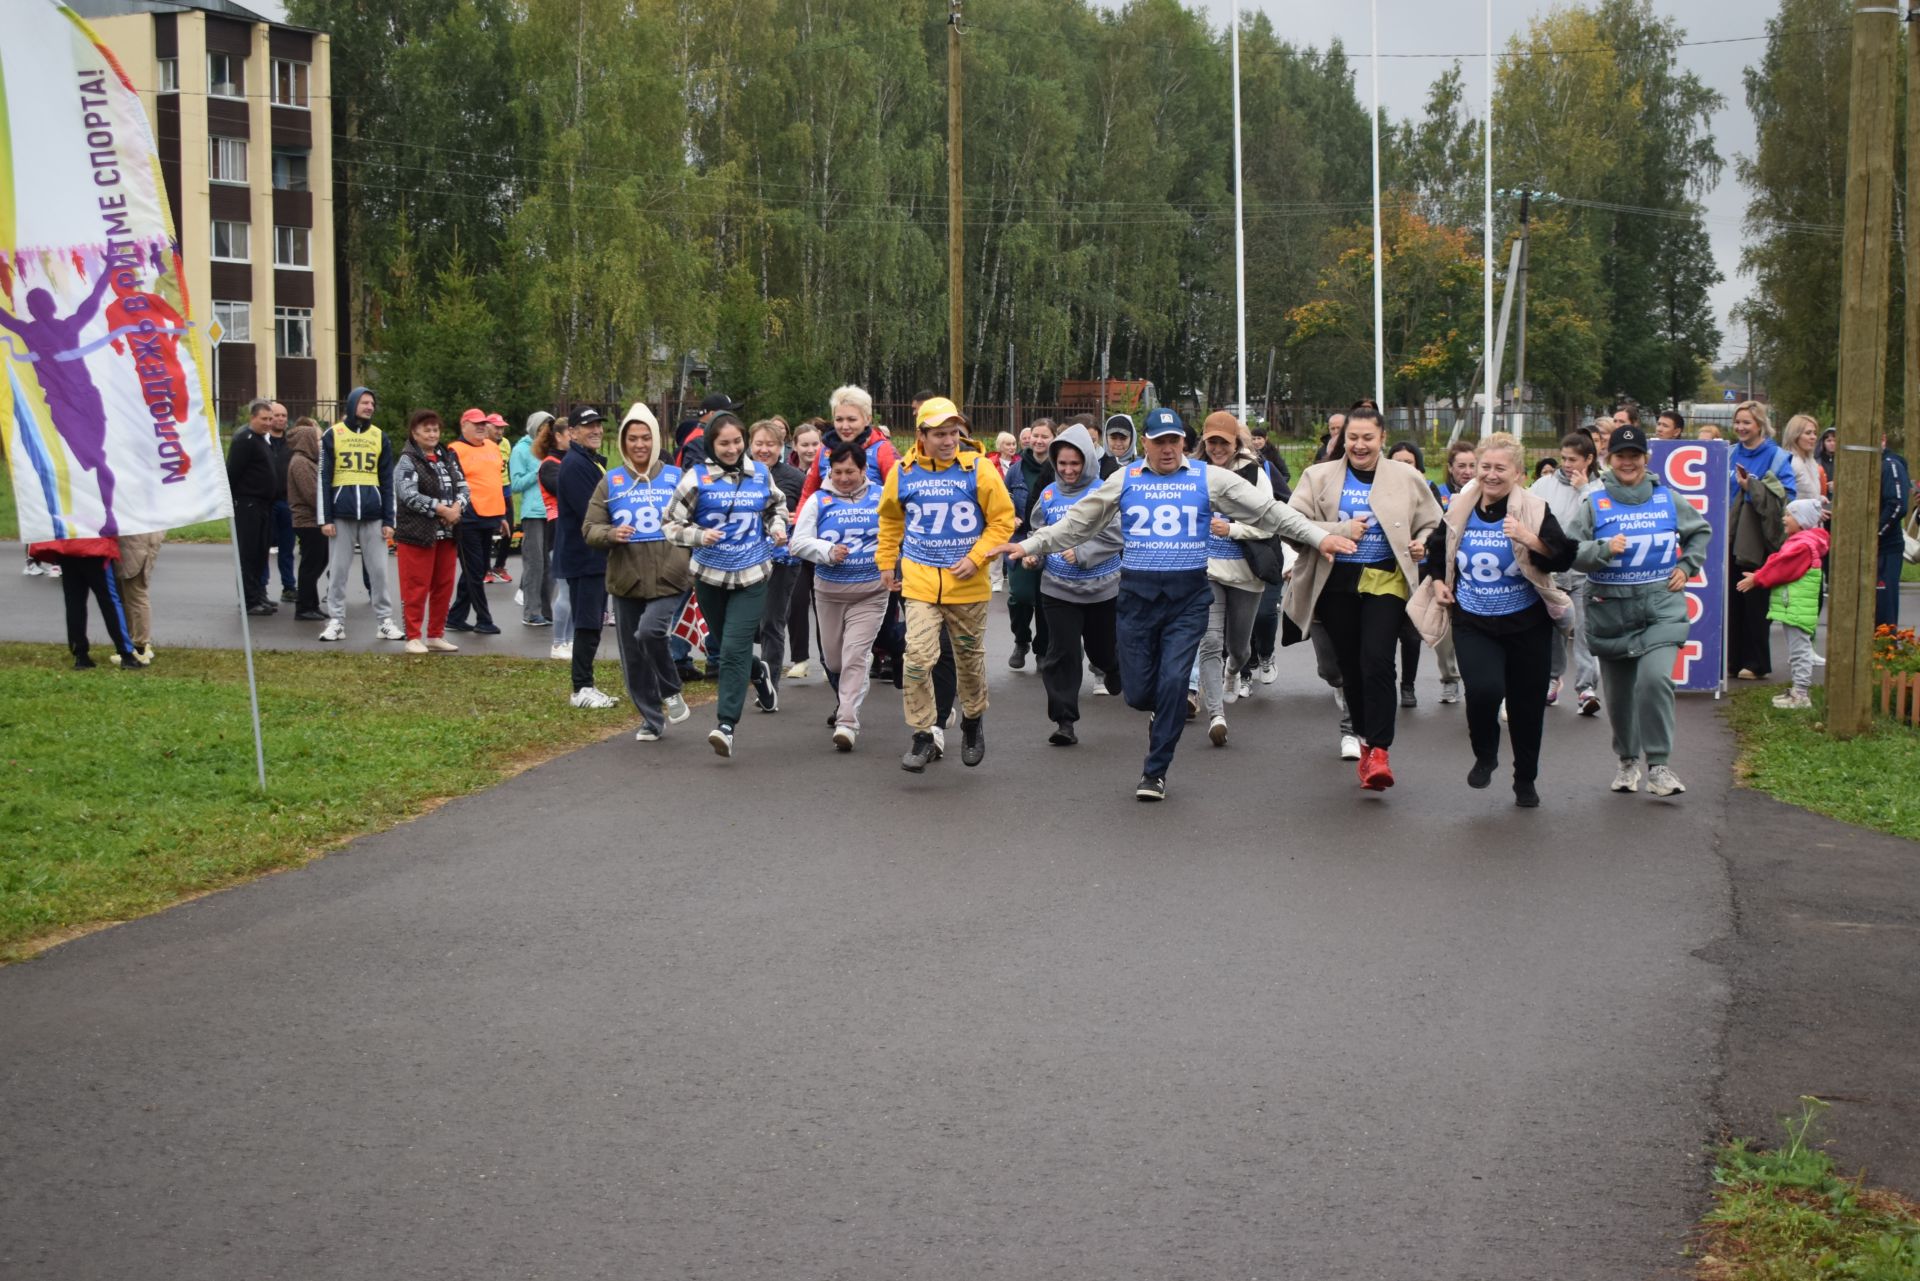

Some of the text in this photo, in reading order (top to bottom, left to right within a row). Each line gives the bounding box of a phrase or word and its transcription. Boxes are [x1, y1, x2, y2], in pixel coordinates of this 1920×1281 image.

[77, 69, 187, 485] МОЛОДЕЖЬ В РИТМЕ СПОРТА!
[339, 451, 377, 472] 315
[907, 479, 967, 491] ТУКАЕВСКИЙ
[1131, 483, 1197, 492] ТУКАЕВСКИЙ
[707, 490, 764, 500] ТУКАЕВСКИЙ
[919, 486, 954, 496] РАЙОН
[1144, 490, 1182, 500] РАЙОН
[630, 495, 663, 504] РАЙОН
[721, 499, 754, 507] РАЙОН
[838, 514, 870, 524] РАЙОН
[905, 501, 978, 534] 278
[1126, 504, 1199, 537] 281
[1604, 510, 1669, 523] ТУКАЕВСКИЙ
[1620, 519, 1656, 530] РАЙОН
[1145, 541, 1180, 550] НОРМА
[1470, 537, 1508, 547] РАЙОН
